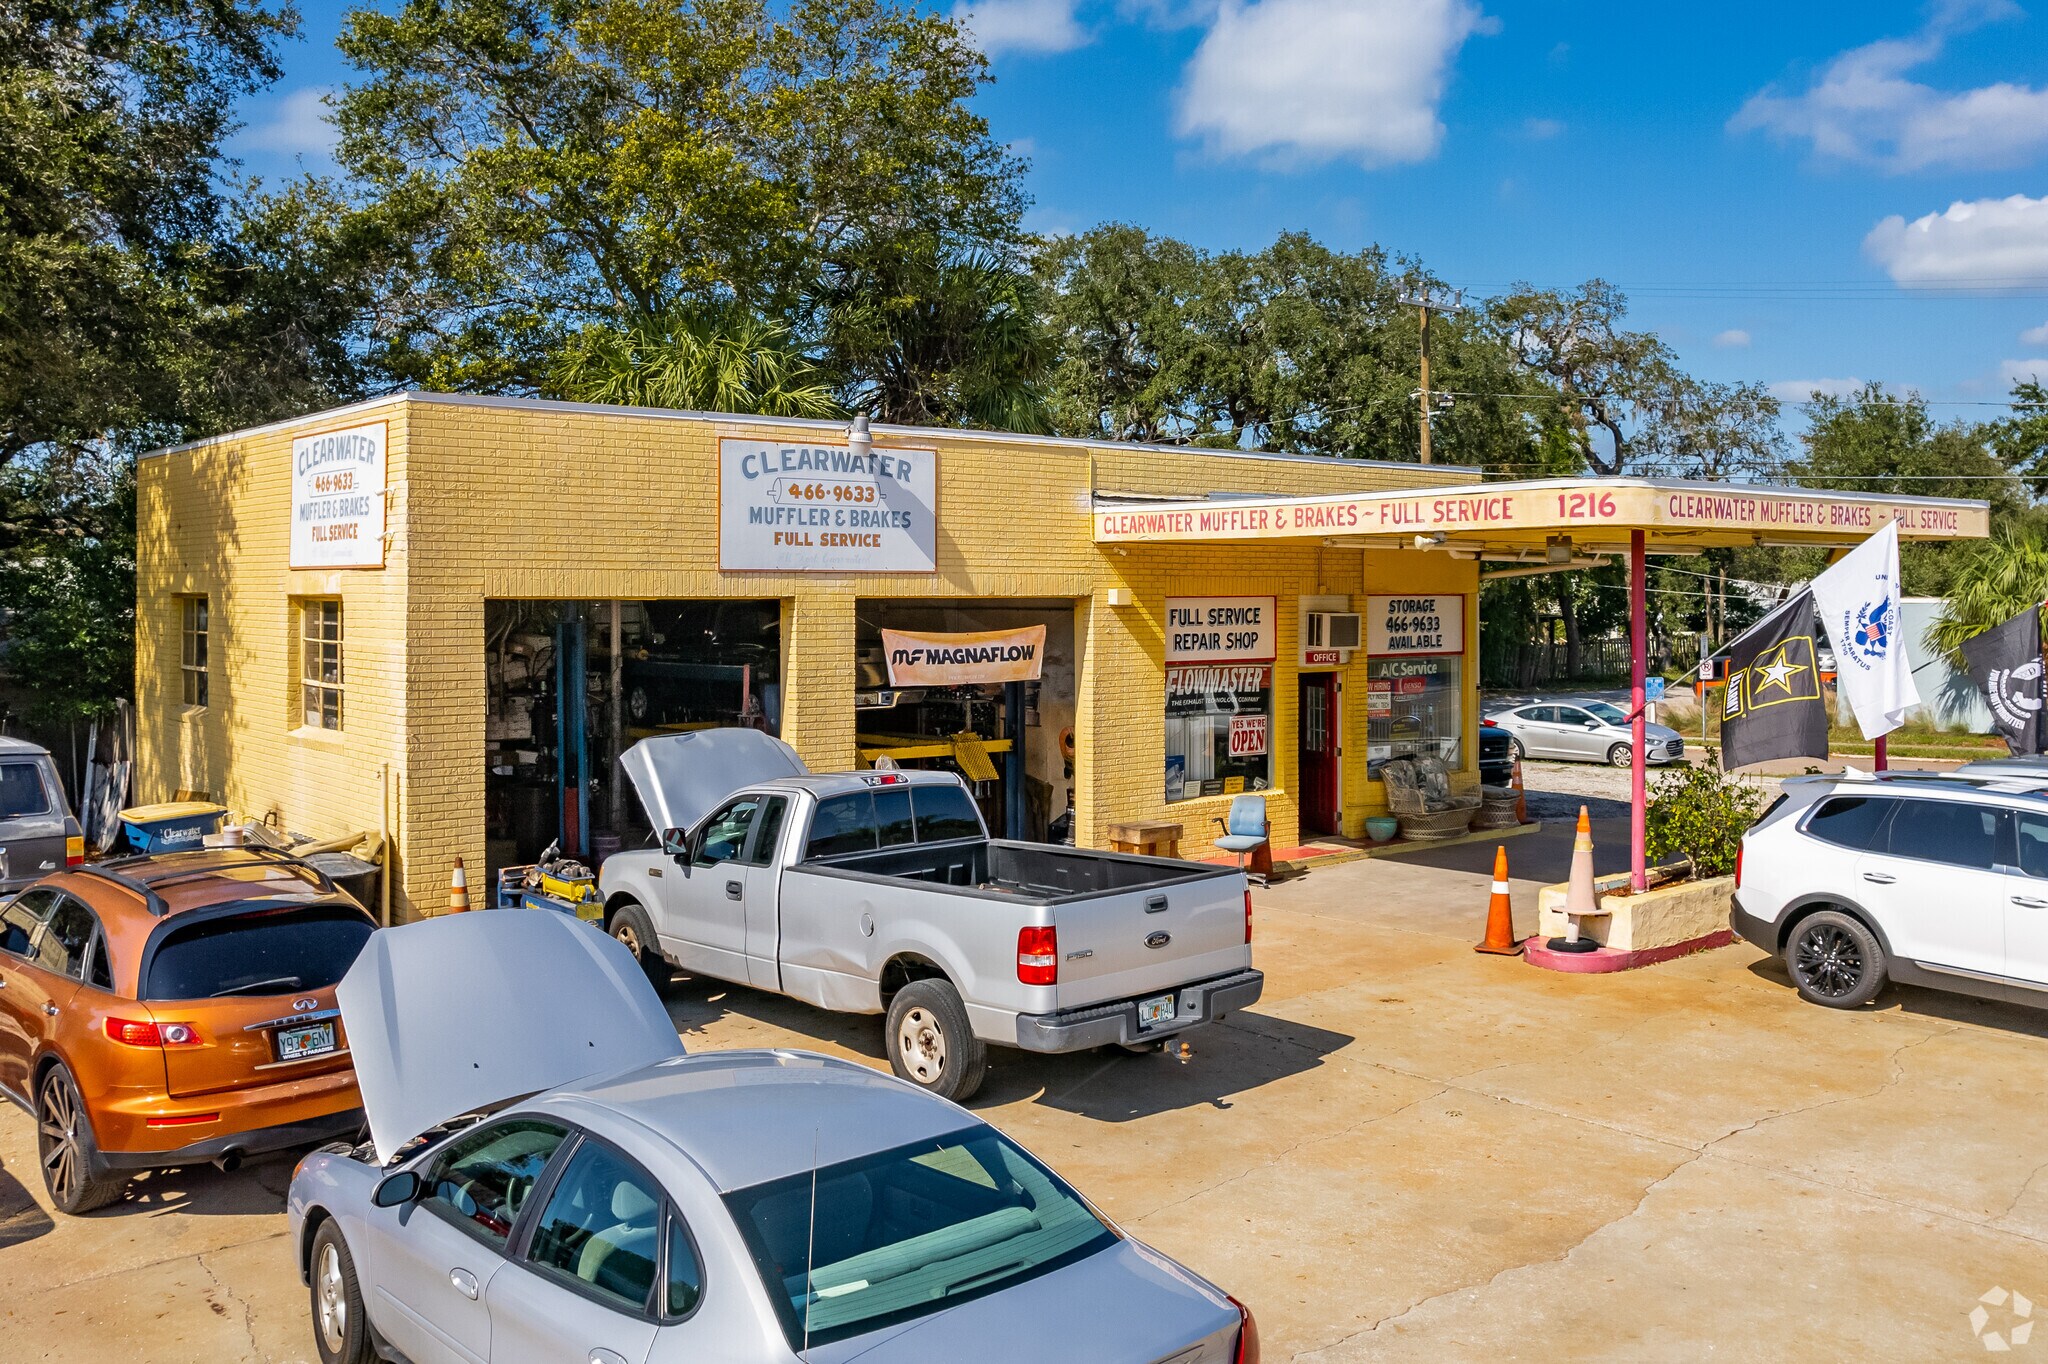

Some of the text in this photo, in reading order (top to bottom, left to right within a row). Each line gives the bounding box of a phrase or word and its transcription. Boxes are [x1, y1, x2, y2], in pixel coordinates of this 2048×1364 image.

[299, 435, 376, 476] CLEARWATER
[742, 449, 912, 483] CLEARWATER
[300, 496, 370, 522] MUFFLER & BRAKES
[1558, 492, 1616, 518] 1216
[1670, 495, 1756, 522] CLEARWATER
[1761, 502, 1813, 524] MUFFLER
[1817, 504, 1826, 524] &
[1830, 505, 1871, 526] BRAKES
[1893, 509, 1916, 528] FULL
[1921, 510, 1958, 530] SERVICE
[749, 507, 912, 528] MUFFLER & BRAKES
[1104, 512, 1193, 534] CLEARWATER
[1200, 510, 1268, 531] MUFFLER
[1275, 508, 1288, 529] &
[1294, 504, 1358, 528] BRAKES
[1380, 502, 1426, 524] FULL
[1433, 498, 1513, 523] SERVICE
[312, 523, 358, 542] FULL SERVICE
[774, 532, 881, 548] FULL SERVICE
[1388, 599, 1436, 614] STORAGE
[1170, 608, 1260, 627] FULL SERVICE
[1173, 632, 1258, 652] REPAIR SHOP
[1388, 634, 1442, 650] AVAILABLE
[926, 645, 1035, 665] MAGNAFLOW
[1313, 653, 1337, 662] OFFICE
[1847, 642, 1871, 671] PARATUS
[1381, 661, 1438, 677] A/C Service
[1166, 668, 1263, 696] FLOWMASTER
[1183, 698, 1204, 706] EXHAUST
[1205, 696, 1236, 704] TECHNOLOGY
[1232, 718, 1266, 729] YES WE'RE
[1232, 729, 1265, 753] OPEN
[164, 826, 201, 839] Clearwater
[1151, 935, 1167, 945] Ford
